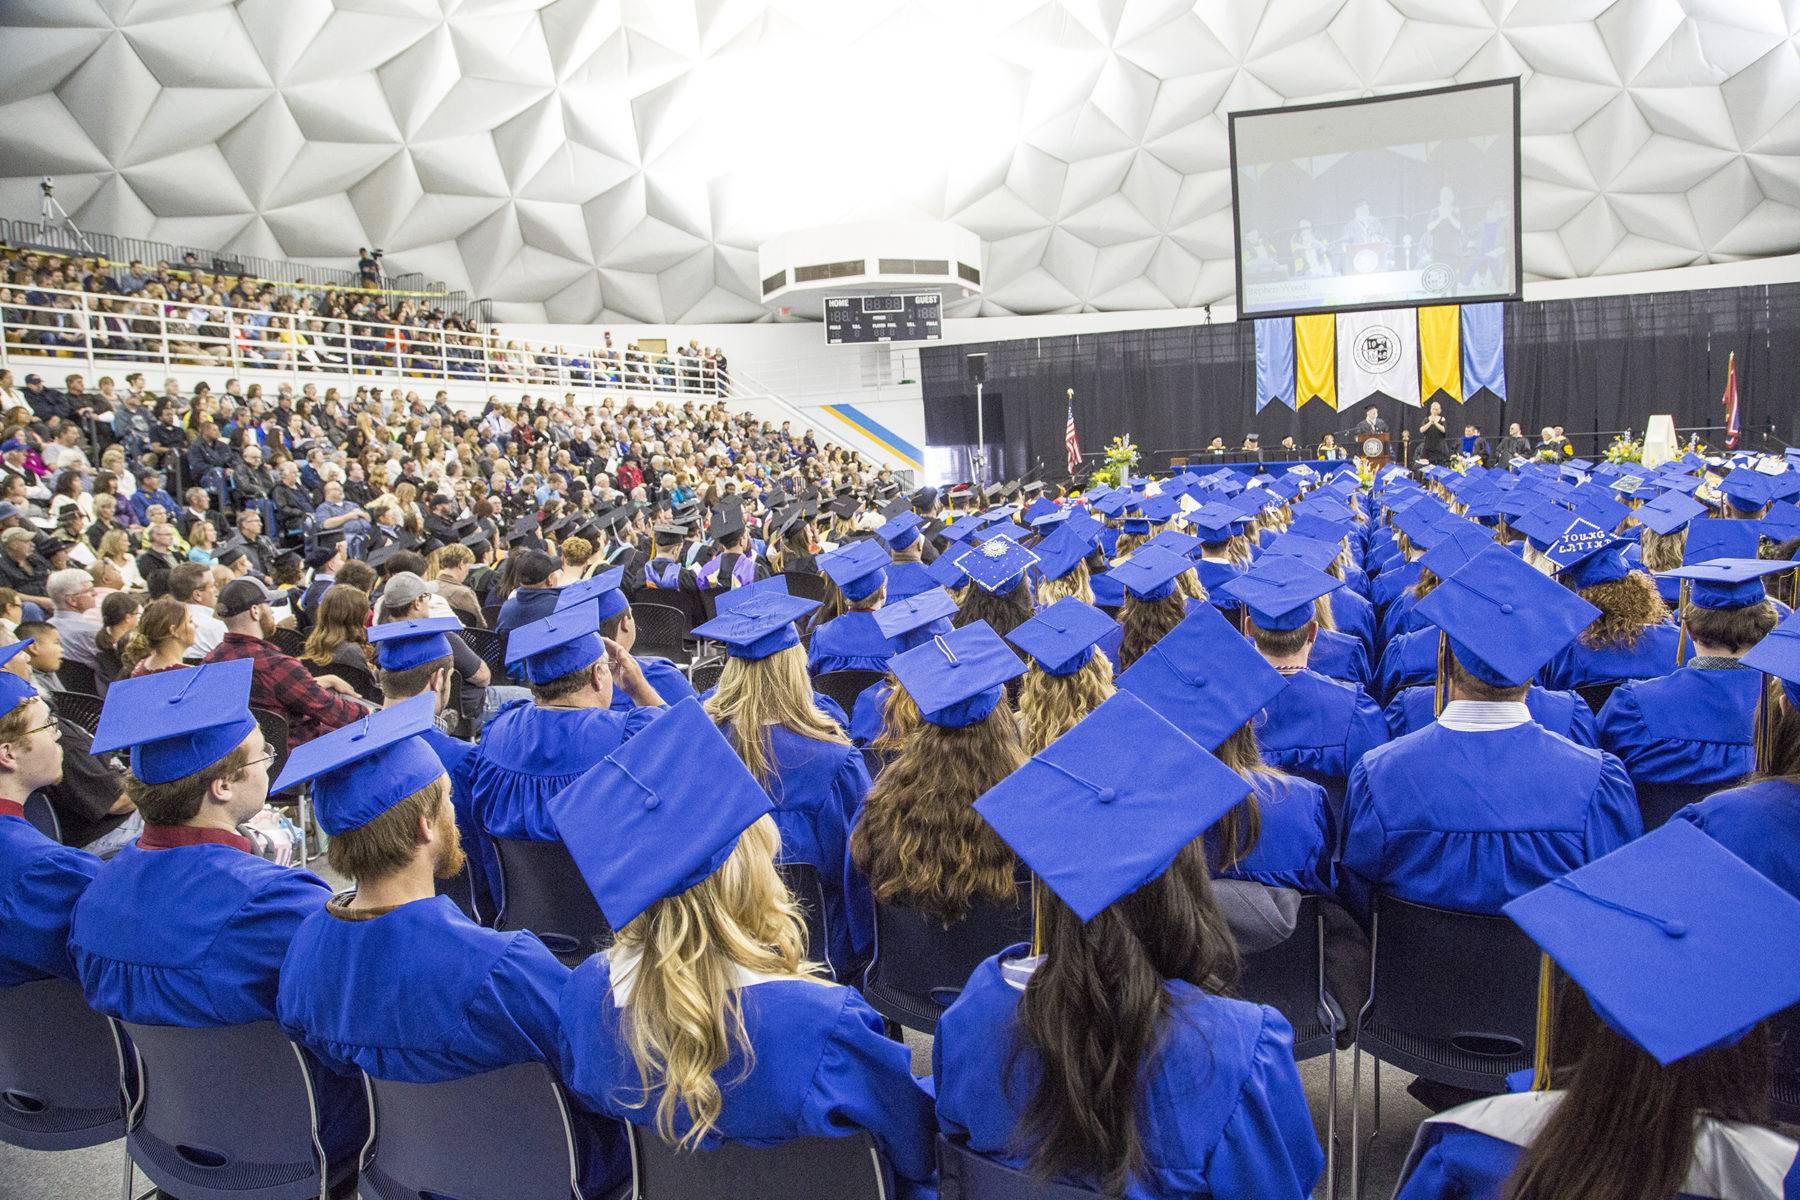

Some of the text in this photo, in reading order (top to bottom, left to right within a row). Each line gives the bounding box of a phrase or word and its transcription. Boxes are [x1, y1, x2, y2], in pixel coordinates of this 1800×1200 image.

[828, 299, 849, 307] HOME
[915, 296, 937, 304] GUEST
[1562, 530, 1606, 543] YOUNG
